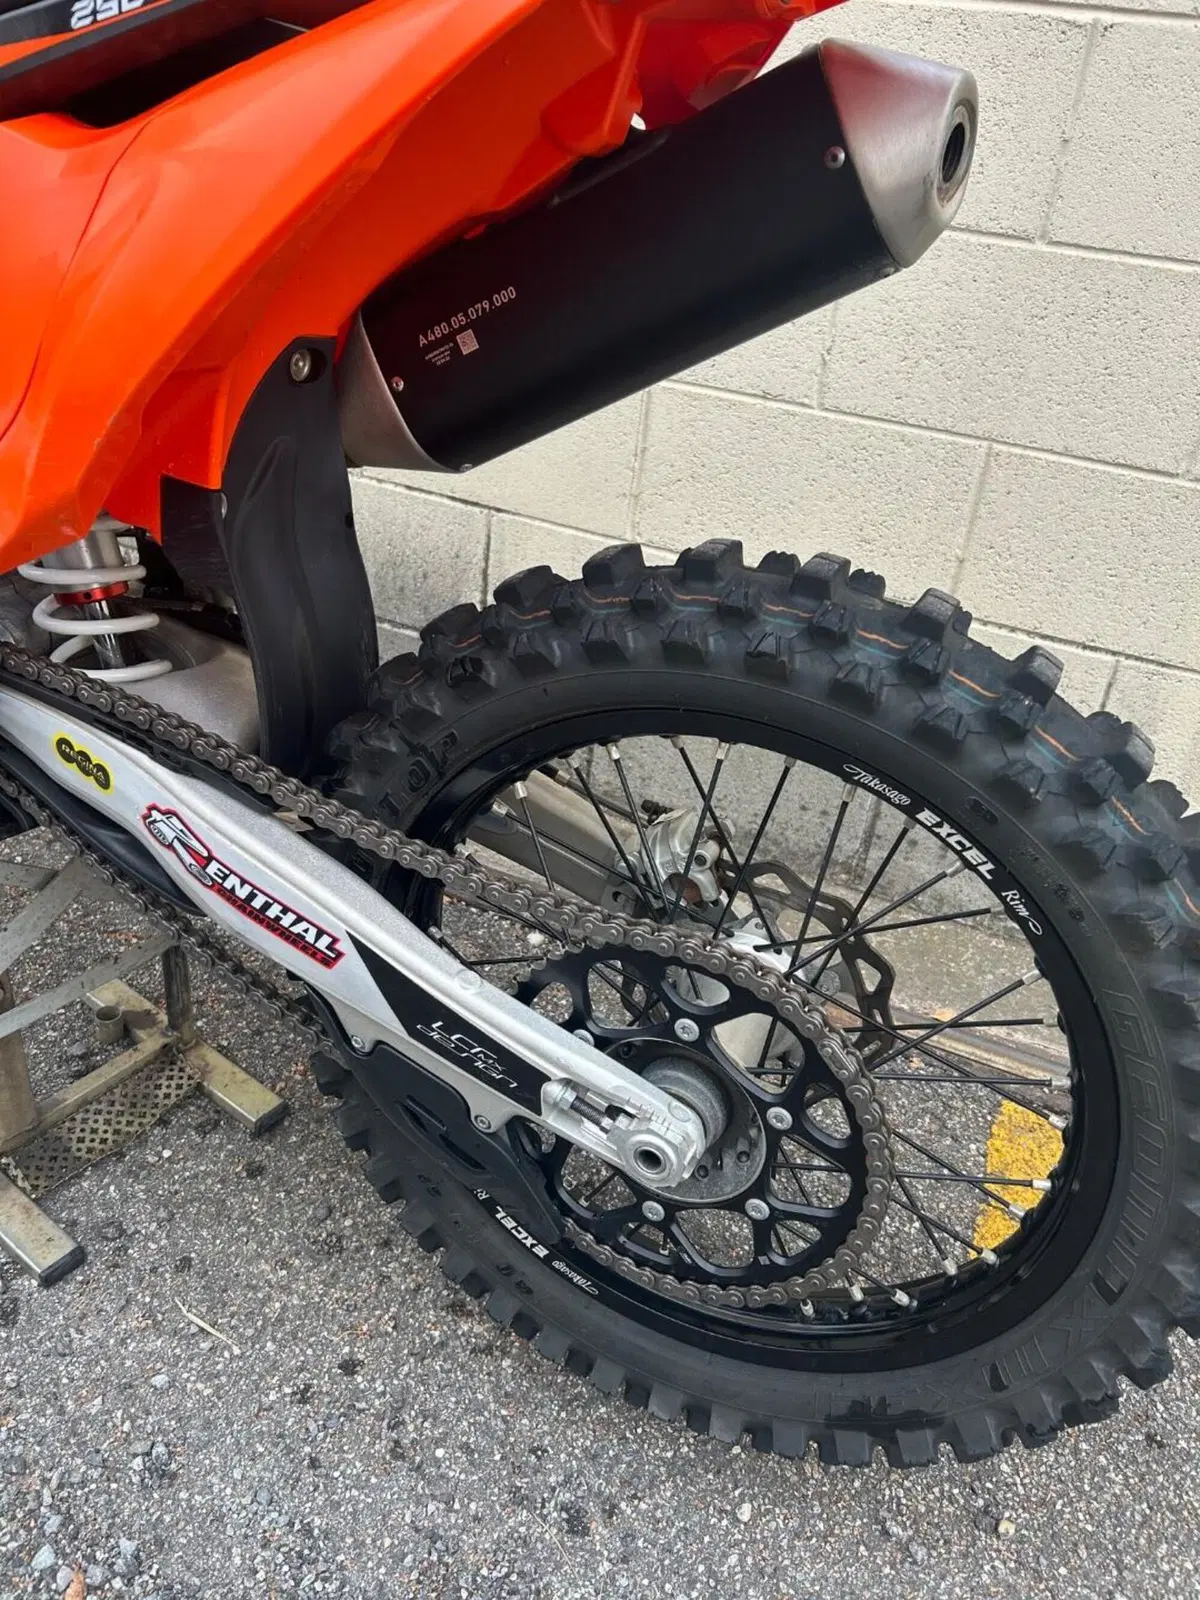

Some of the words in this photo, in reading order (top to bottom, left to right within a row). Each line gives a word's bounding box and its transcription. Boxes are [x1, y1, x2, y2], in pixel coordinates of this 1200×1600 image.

[418, 286, 517, 347] A480.05.079.000
[842, 763, 911, 806] Takasago
[915, 807, 996, 880] EXCEL
[1001, 889, 1043, 936] Rim
[474, 1188, 490, 1200] Ri
[495, 1206, 549, 1259] EXCEL
[552, 1260, 598, 1295] Takasago
